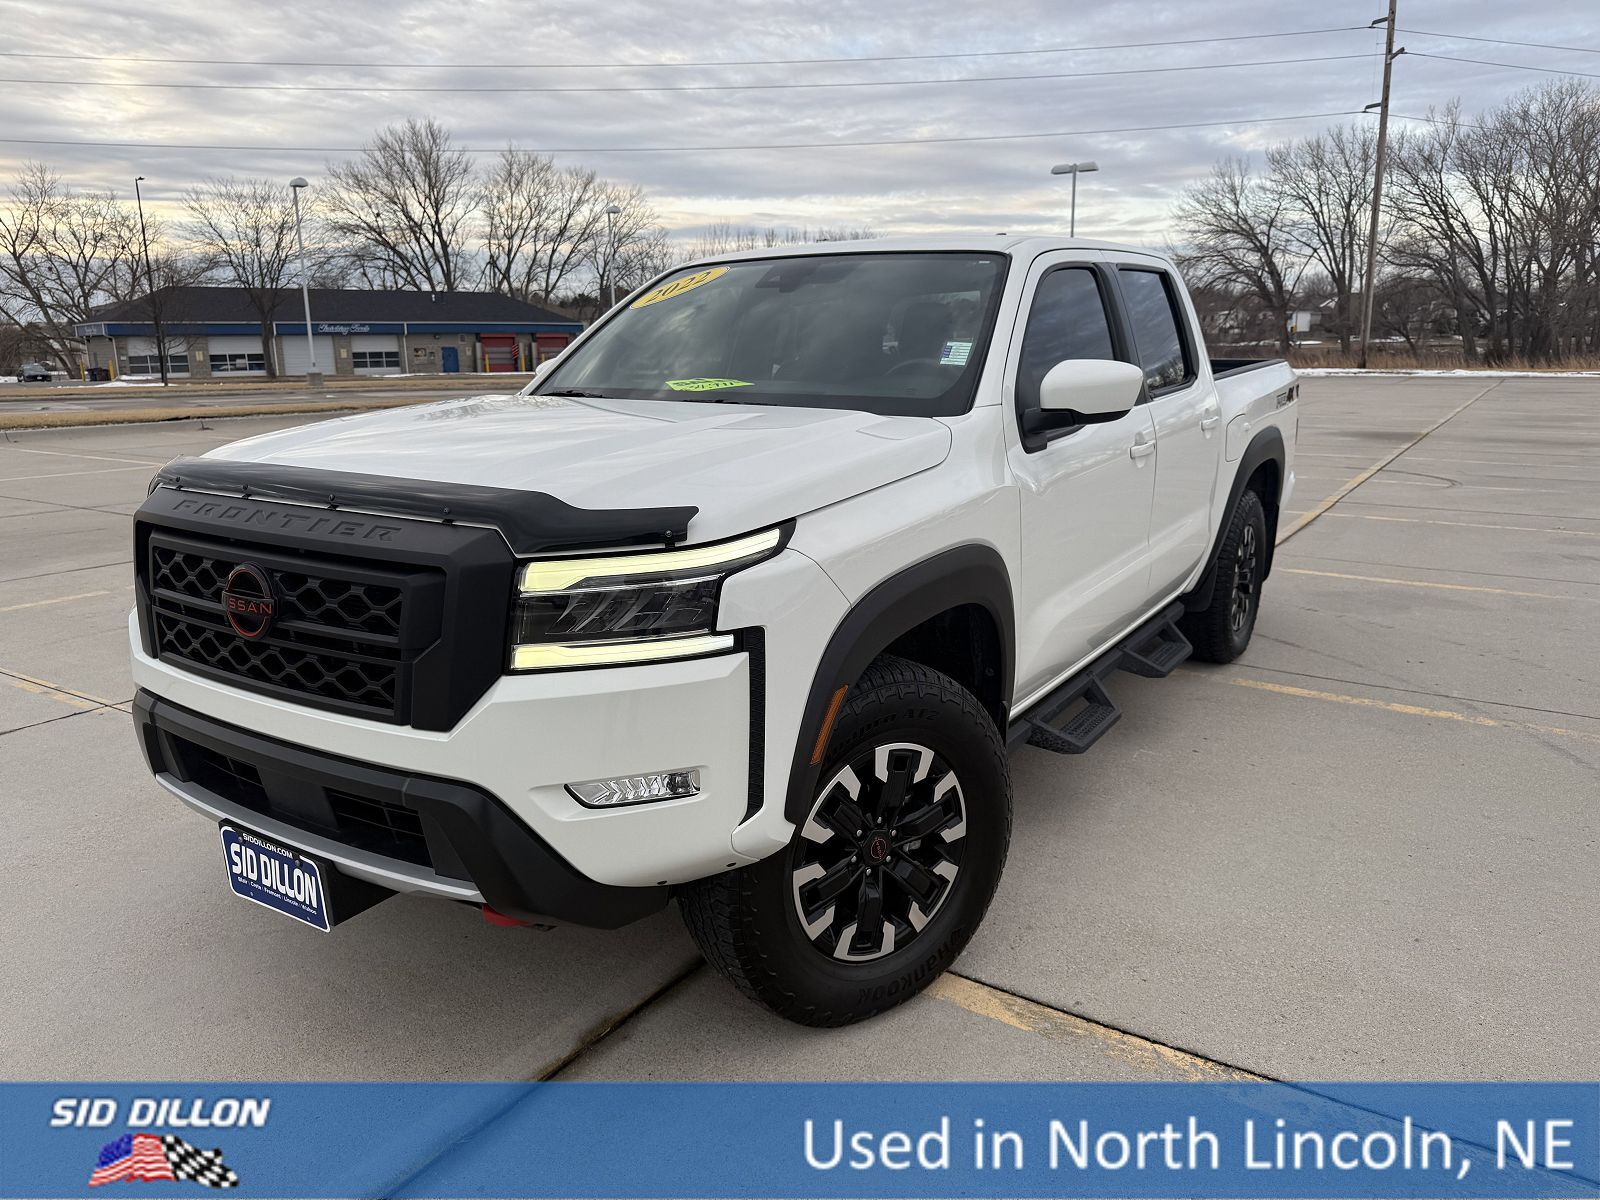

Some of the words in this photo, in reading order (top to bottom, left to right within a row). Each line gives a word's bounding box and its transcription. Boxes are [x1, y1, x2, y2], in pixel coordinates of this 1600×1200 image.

[645, 271, 712, 304] 2022
[172, 499, 402, 542] FRONTIER
[242, 833, 294, 860] SIDDILLON.COM
[230, 842, 258, 881] SID
[259, 853, 318, 909] DILLON
